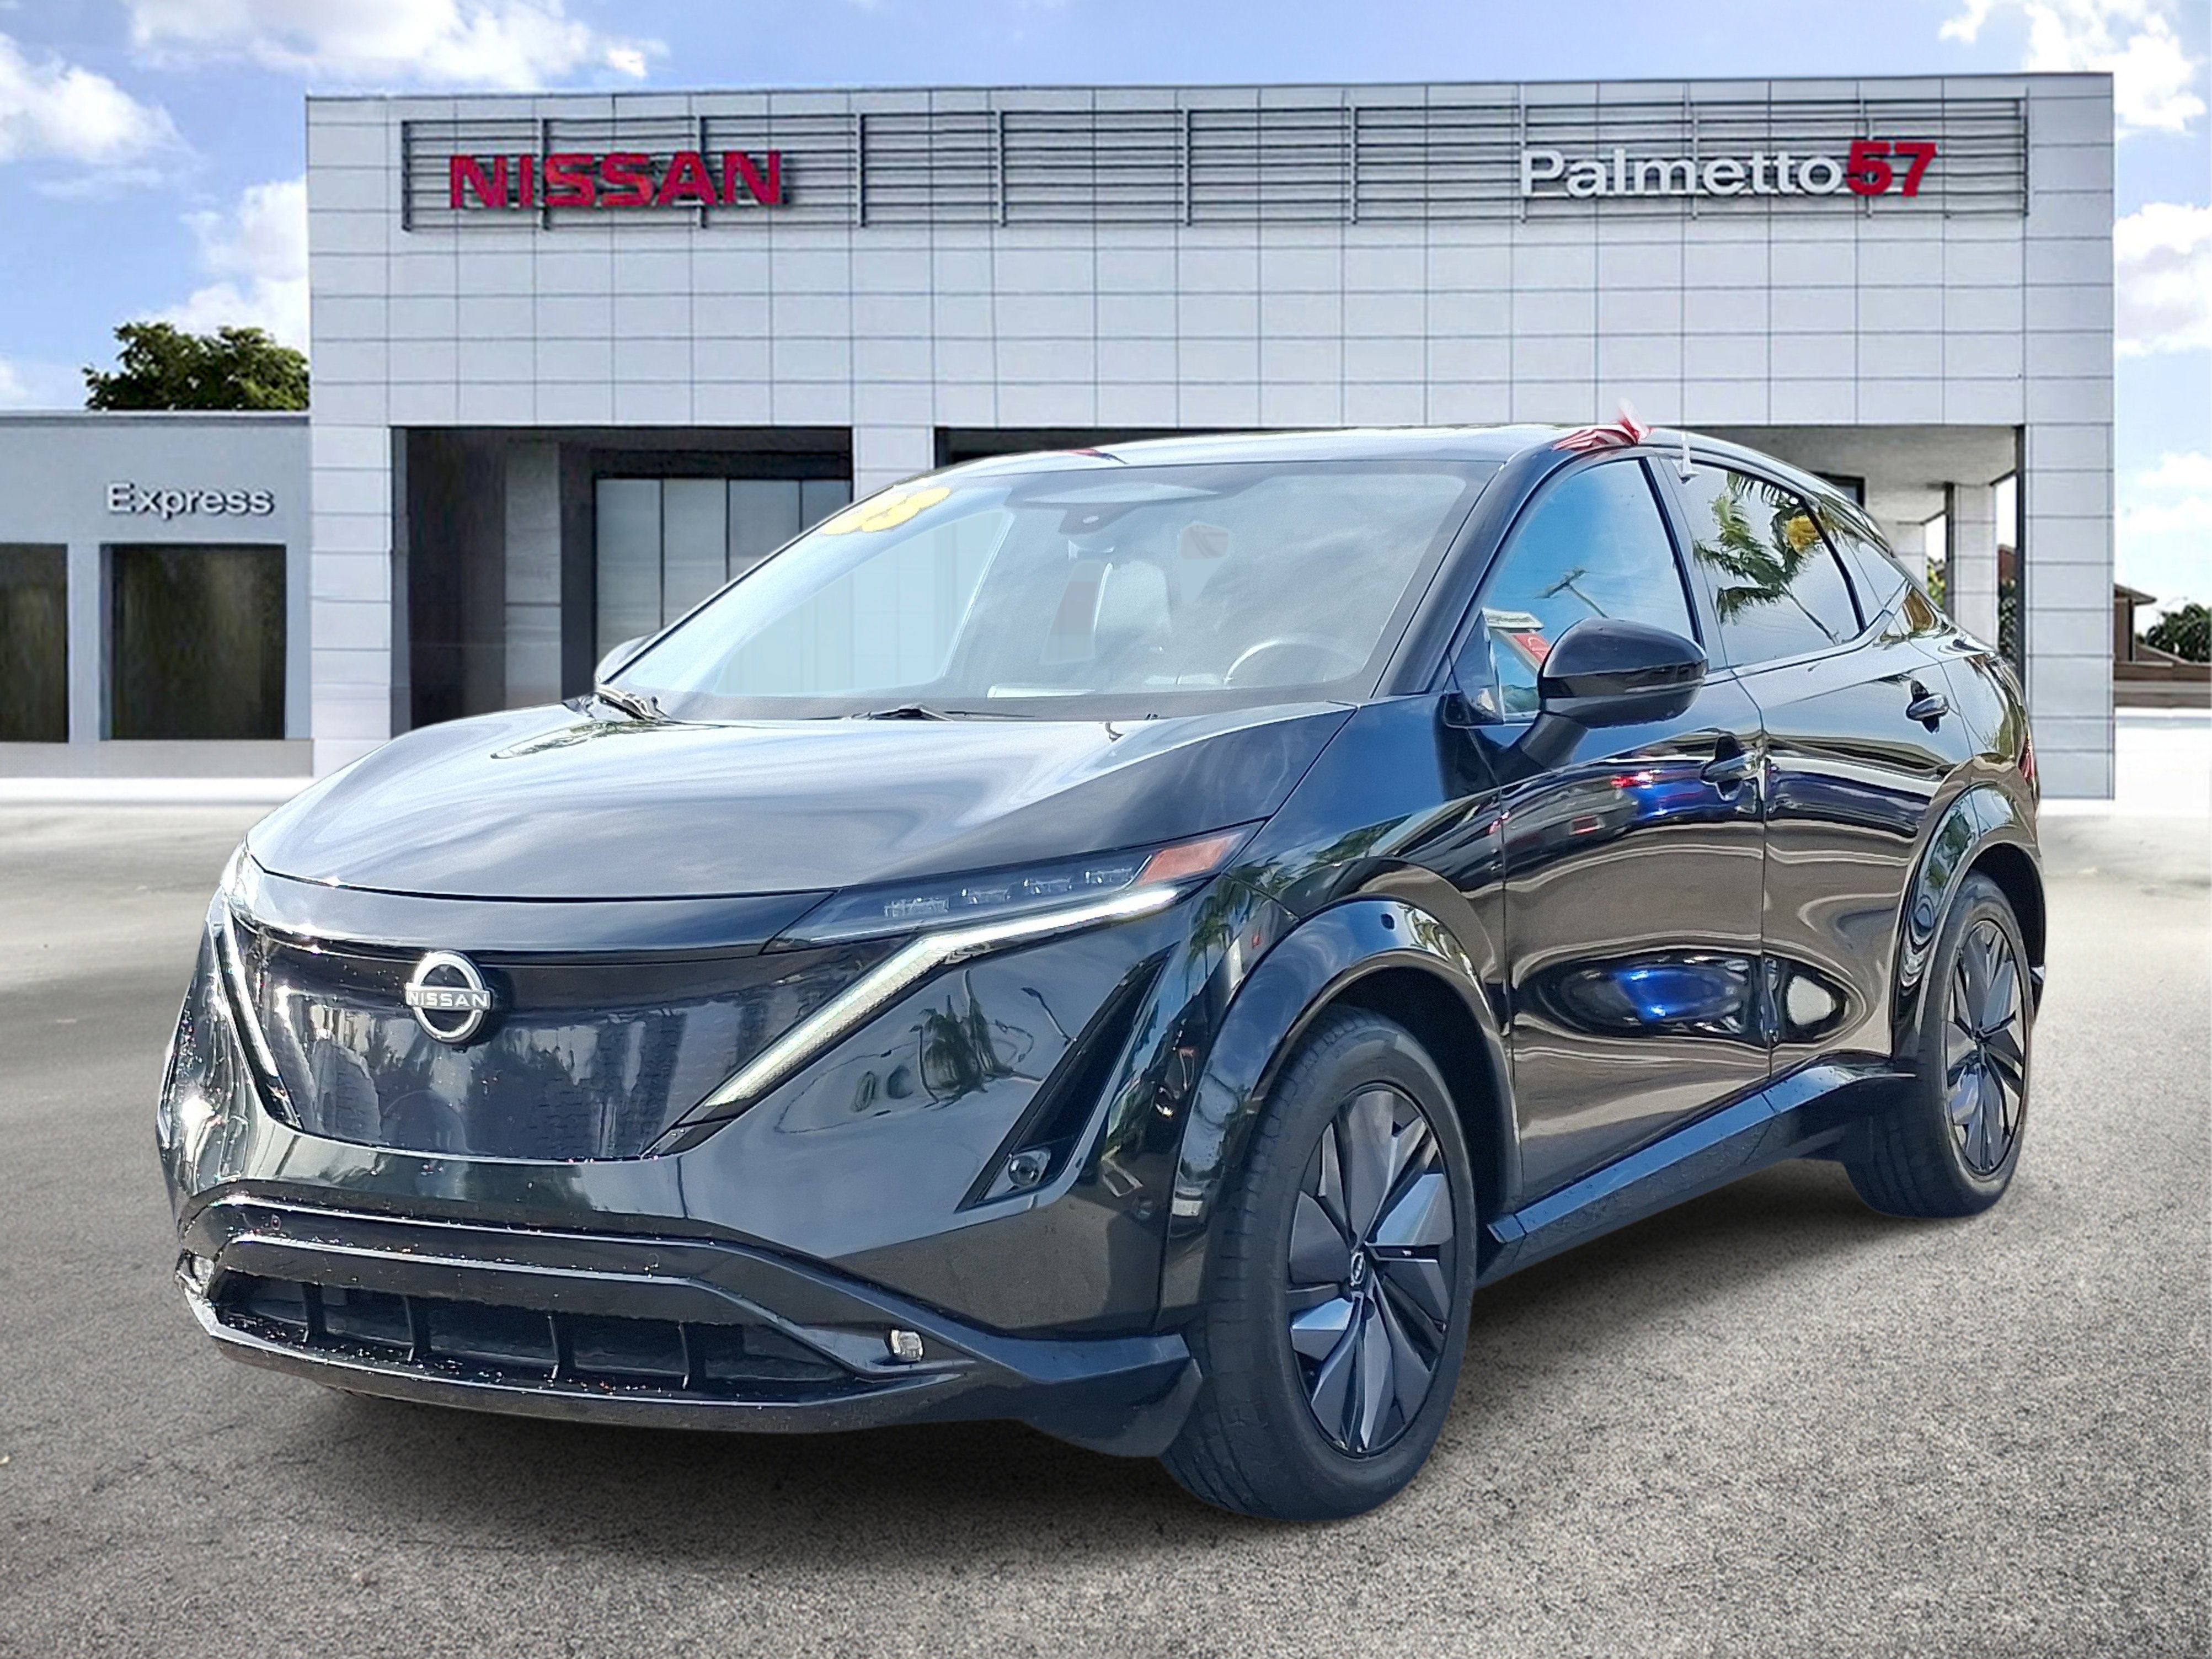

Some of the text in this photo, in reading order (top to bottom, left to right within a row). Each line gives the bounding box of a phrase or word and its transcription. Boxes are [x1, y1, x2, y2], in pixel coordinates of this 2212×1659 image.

[450, 151, 782, 209] NISSAN
[108, 483, 273, 520] Express
[408, 991, 487, 1007] NISSAN
